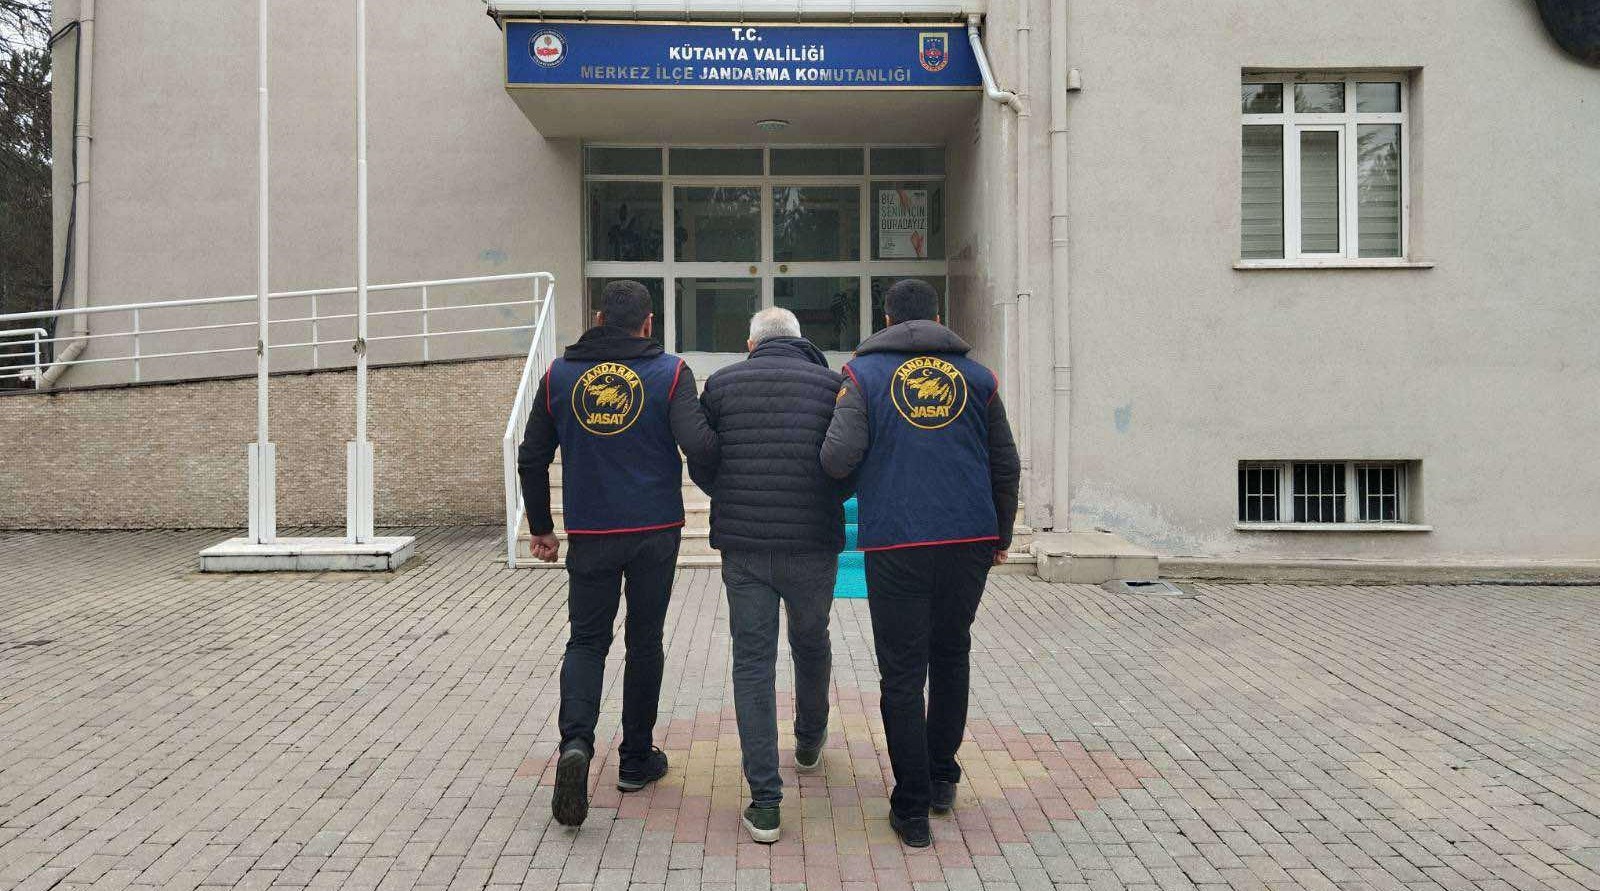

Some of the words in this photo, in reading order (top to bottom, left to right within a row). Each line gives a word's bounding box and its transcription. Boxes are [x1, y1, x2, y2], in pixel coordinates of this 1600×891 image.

[732, 28, 762, 41] T.C.
[669, 44, 748, 61] KÜTAHYA
[753, 45, 825, 61] VALİLİĞİ
[580, 65, 651, 80] MERKEZ
[656, 64, 694, 84] İLÇE
[699, 67, 790, 82] JANDARMA
[795, 66, 911, 82] KOMUTANLIĞI
[581, 364, 639, 388] JANDARMA
[897, 358, 958, 381] JANDARMA
[586, 412, 626, 425] JASAT
[910, 405, 950, 418] JASAT
